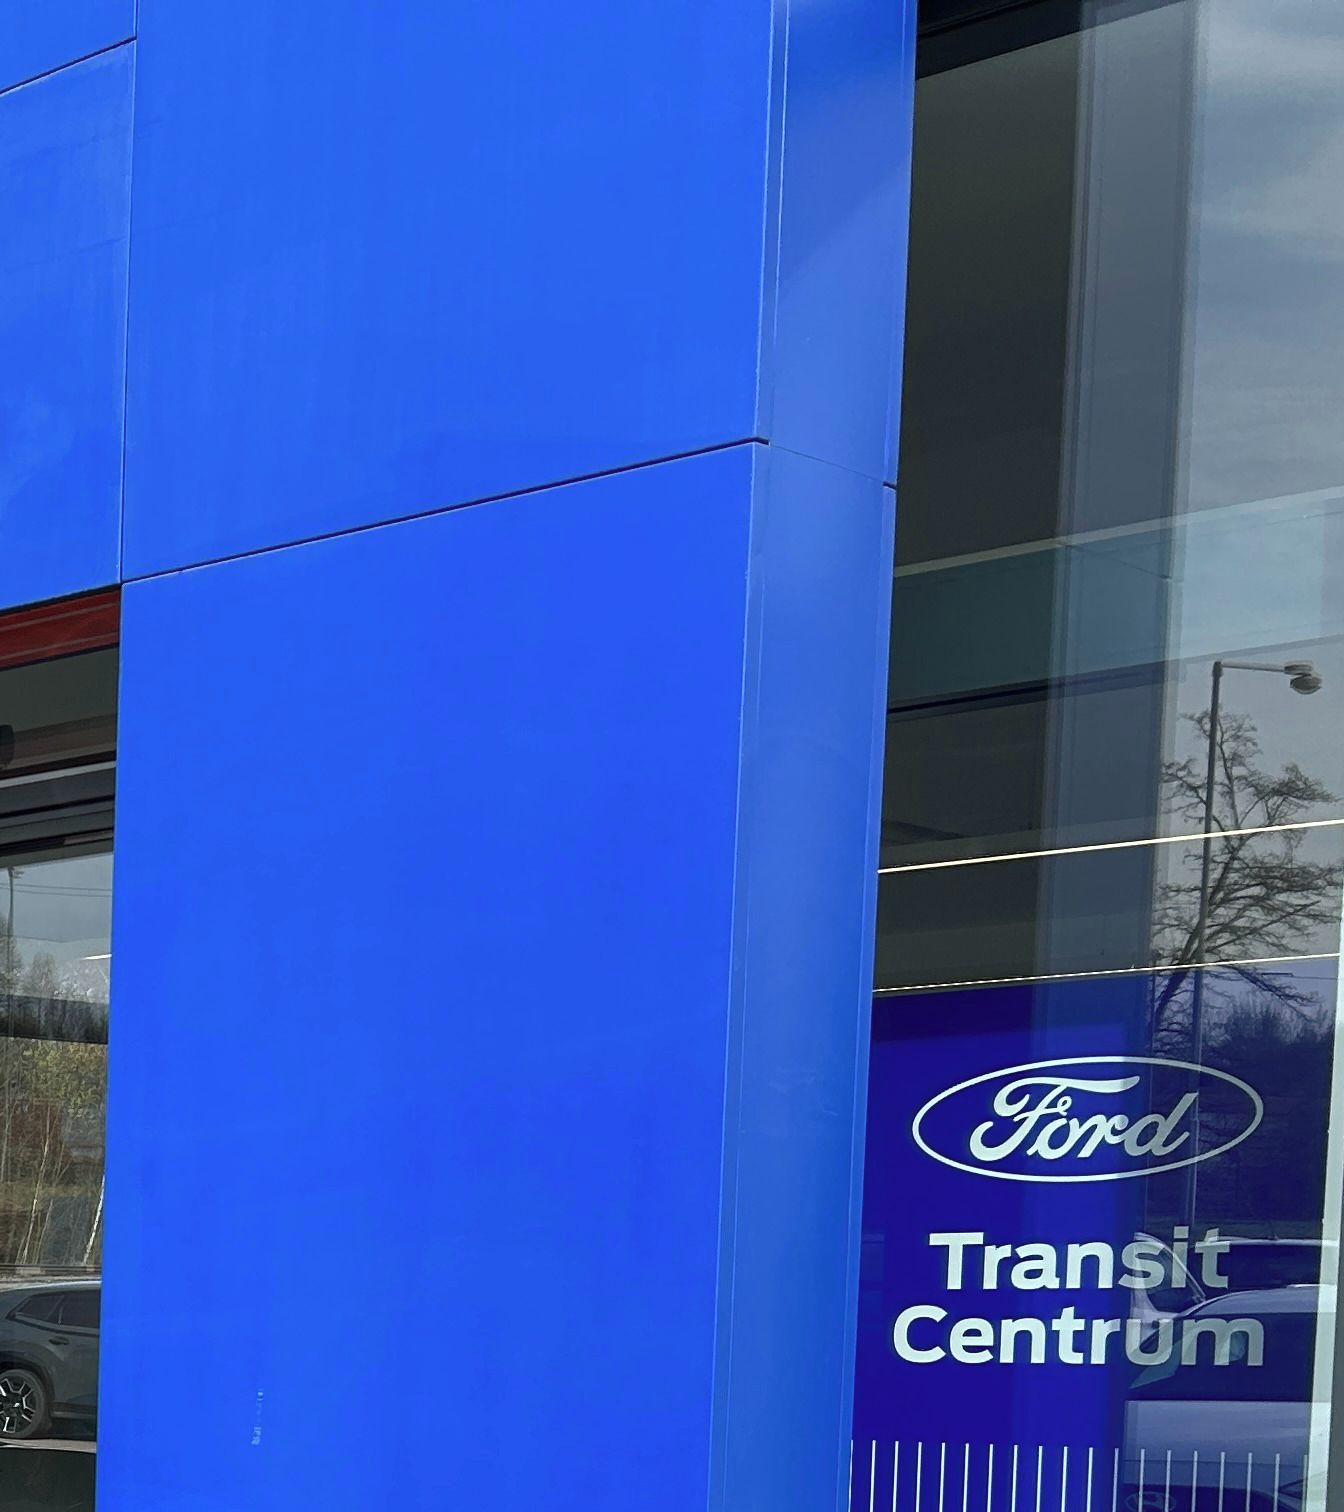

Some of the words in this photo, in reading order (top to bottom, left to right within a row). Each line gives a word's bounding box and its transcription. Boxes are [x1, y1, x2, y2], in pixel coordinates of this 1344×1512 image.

[969, 1075, 1200, 1162] Ford
[929, 1225, 1231, 1291] Transit
[893, 1304, 1265, 1367] Centrum
